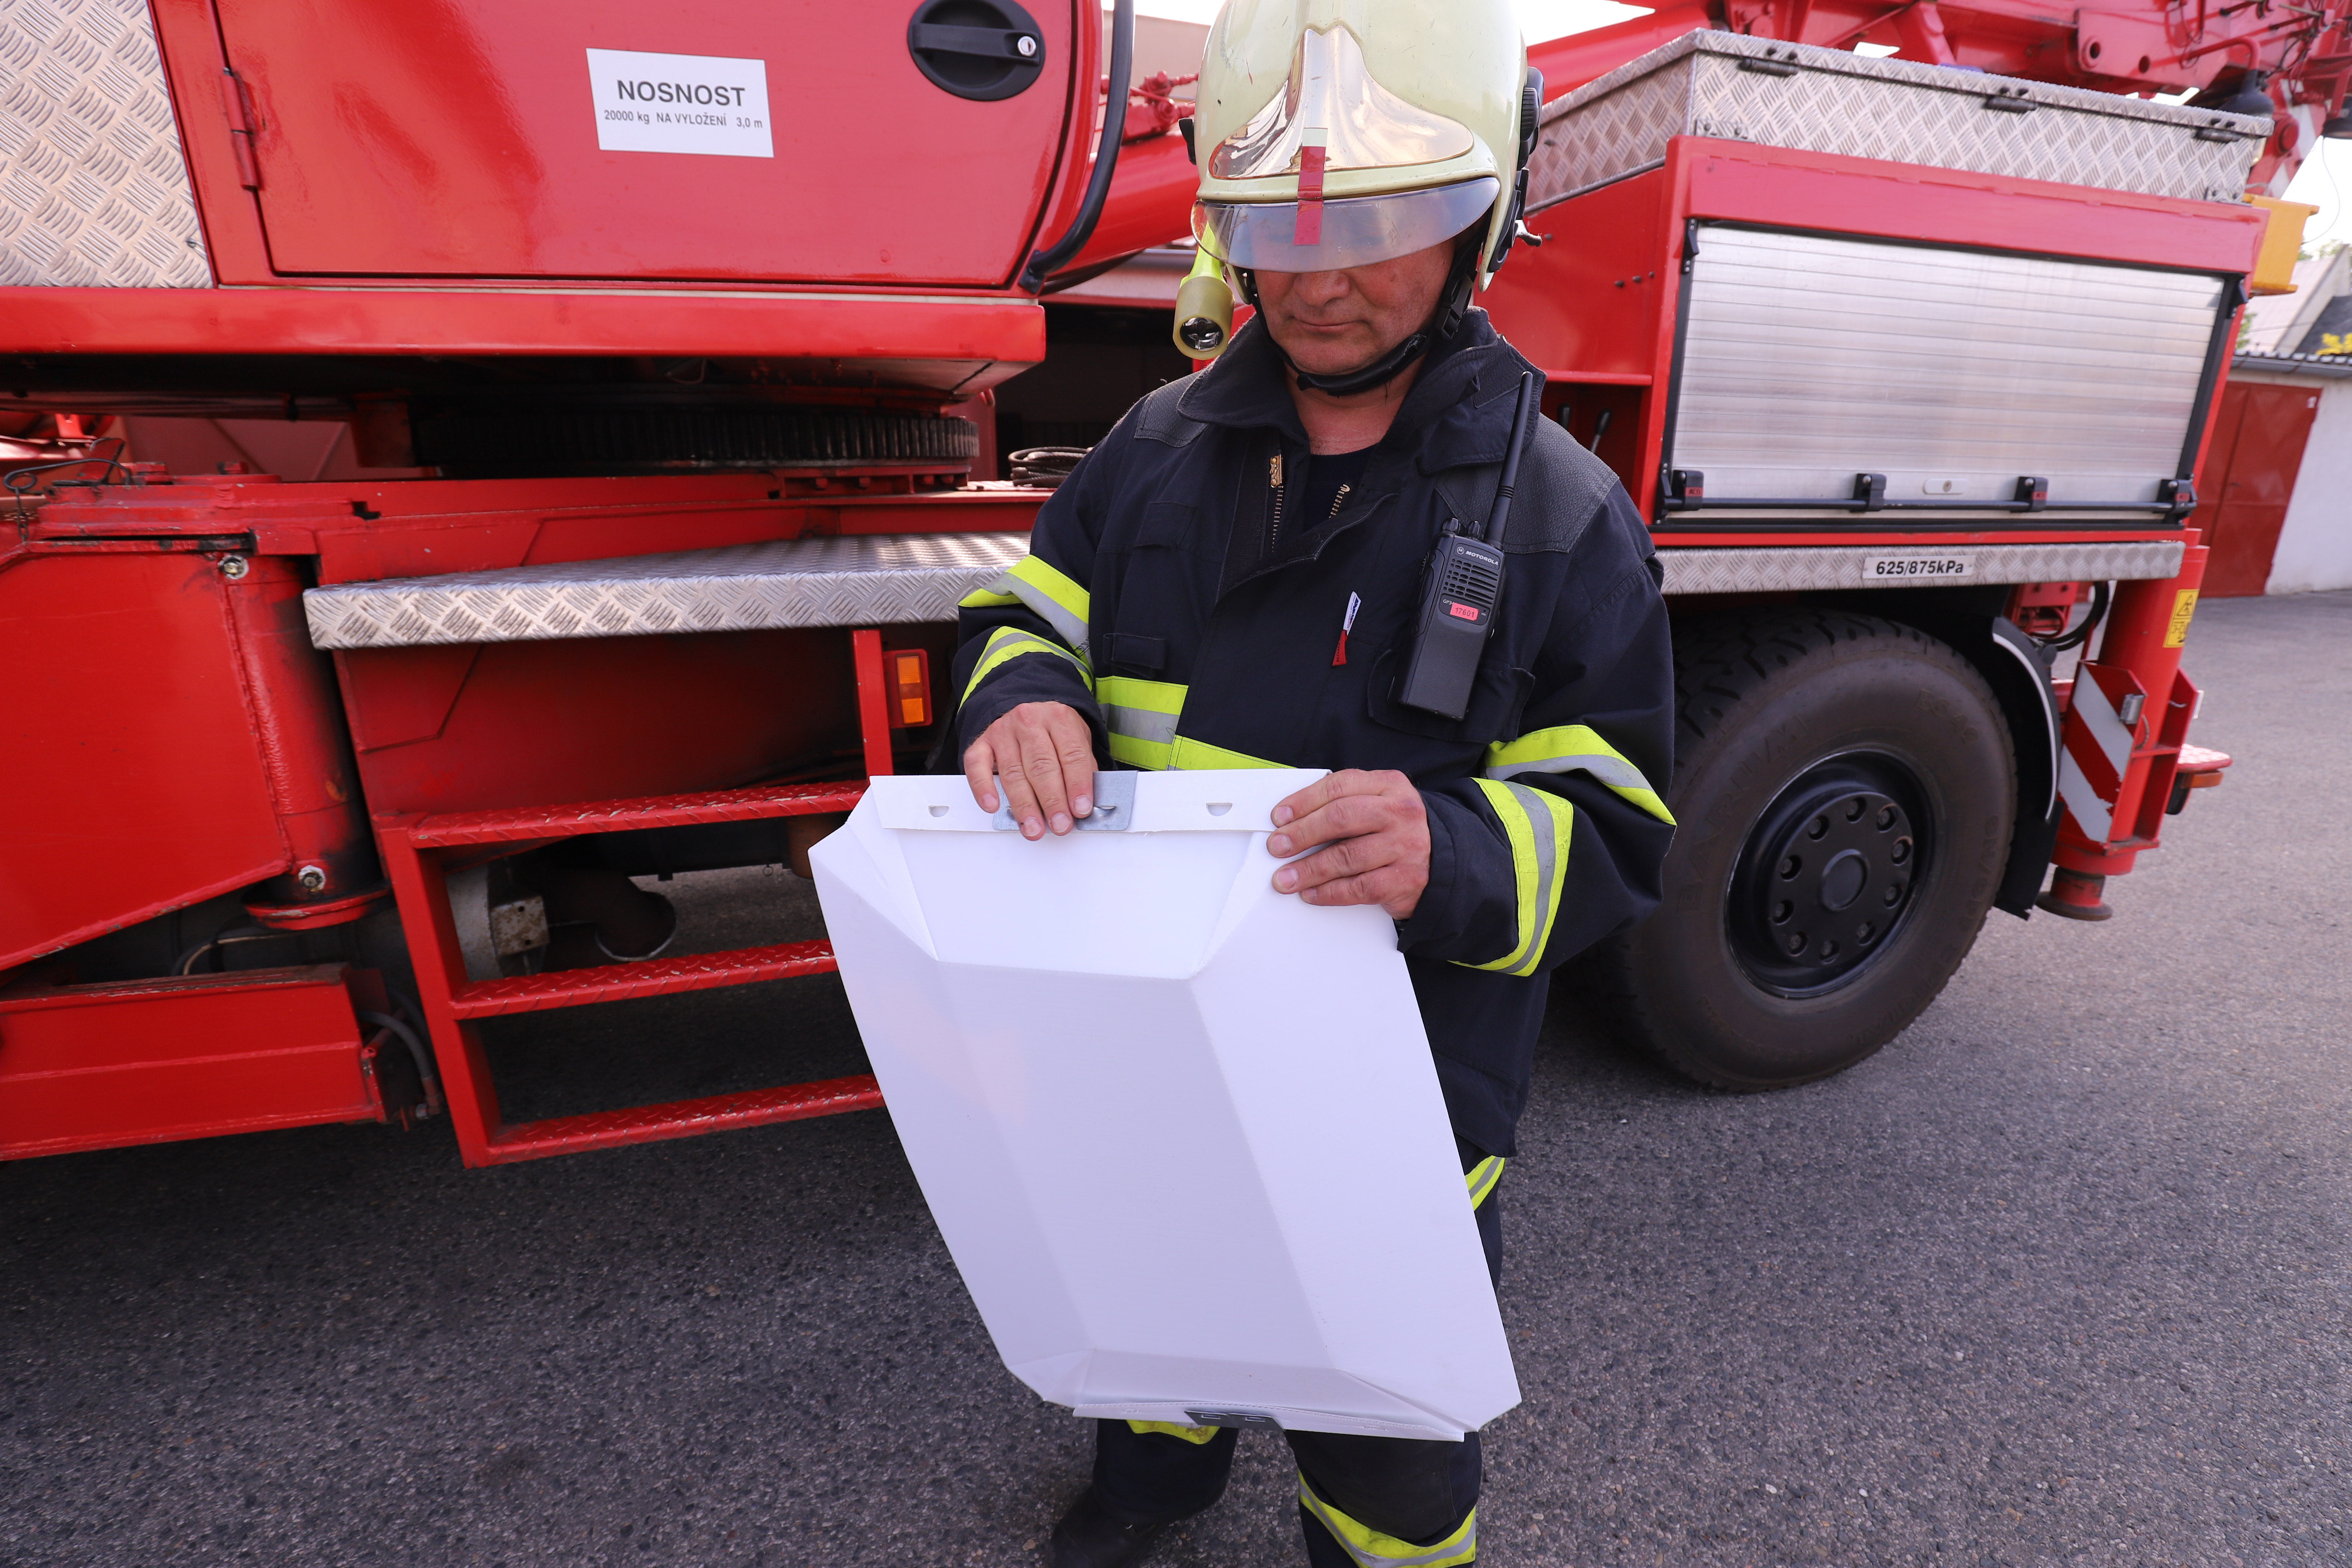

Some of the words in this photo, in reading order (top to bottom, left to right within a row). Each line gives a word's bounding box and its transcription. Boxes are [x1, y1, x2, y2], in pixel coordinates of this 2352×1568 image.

[617, 80, 745, 106] NOSNOST
[604, 109, 634, 121] 20000
[637, 111, 649, 124] kg
[656, 112, 672, 123] NA
[674, 111, 727, 126] VYLOŽENÍ
[736, 116, 750, 129] 3,0
[754, 119, 763, 128] m
[1465, 551, 1498, 566] MOTOROLA
[1876, 560, 1964, 576] 625/875kPa
[1455, 607, 1475, 617] 17601
[1677, 714, 1808, 914] BARUM
